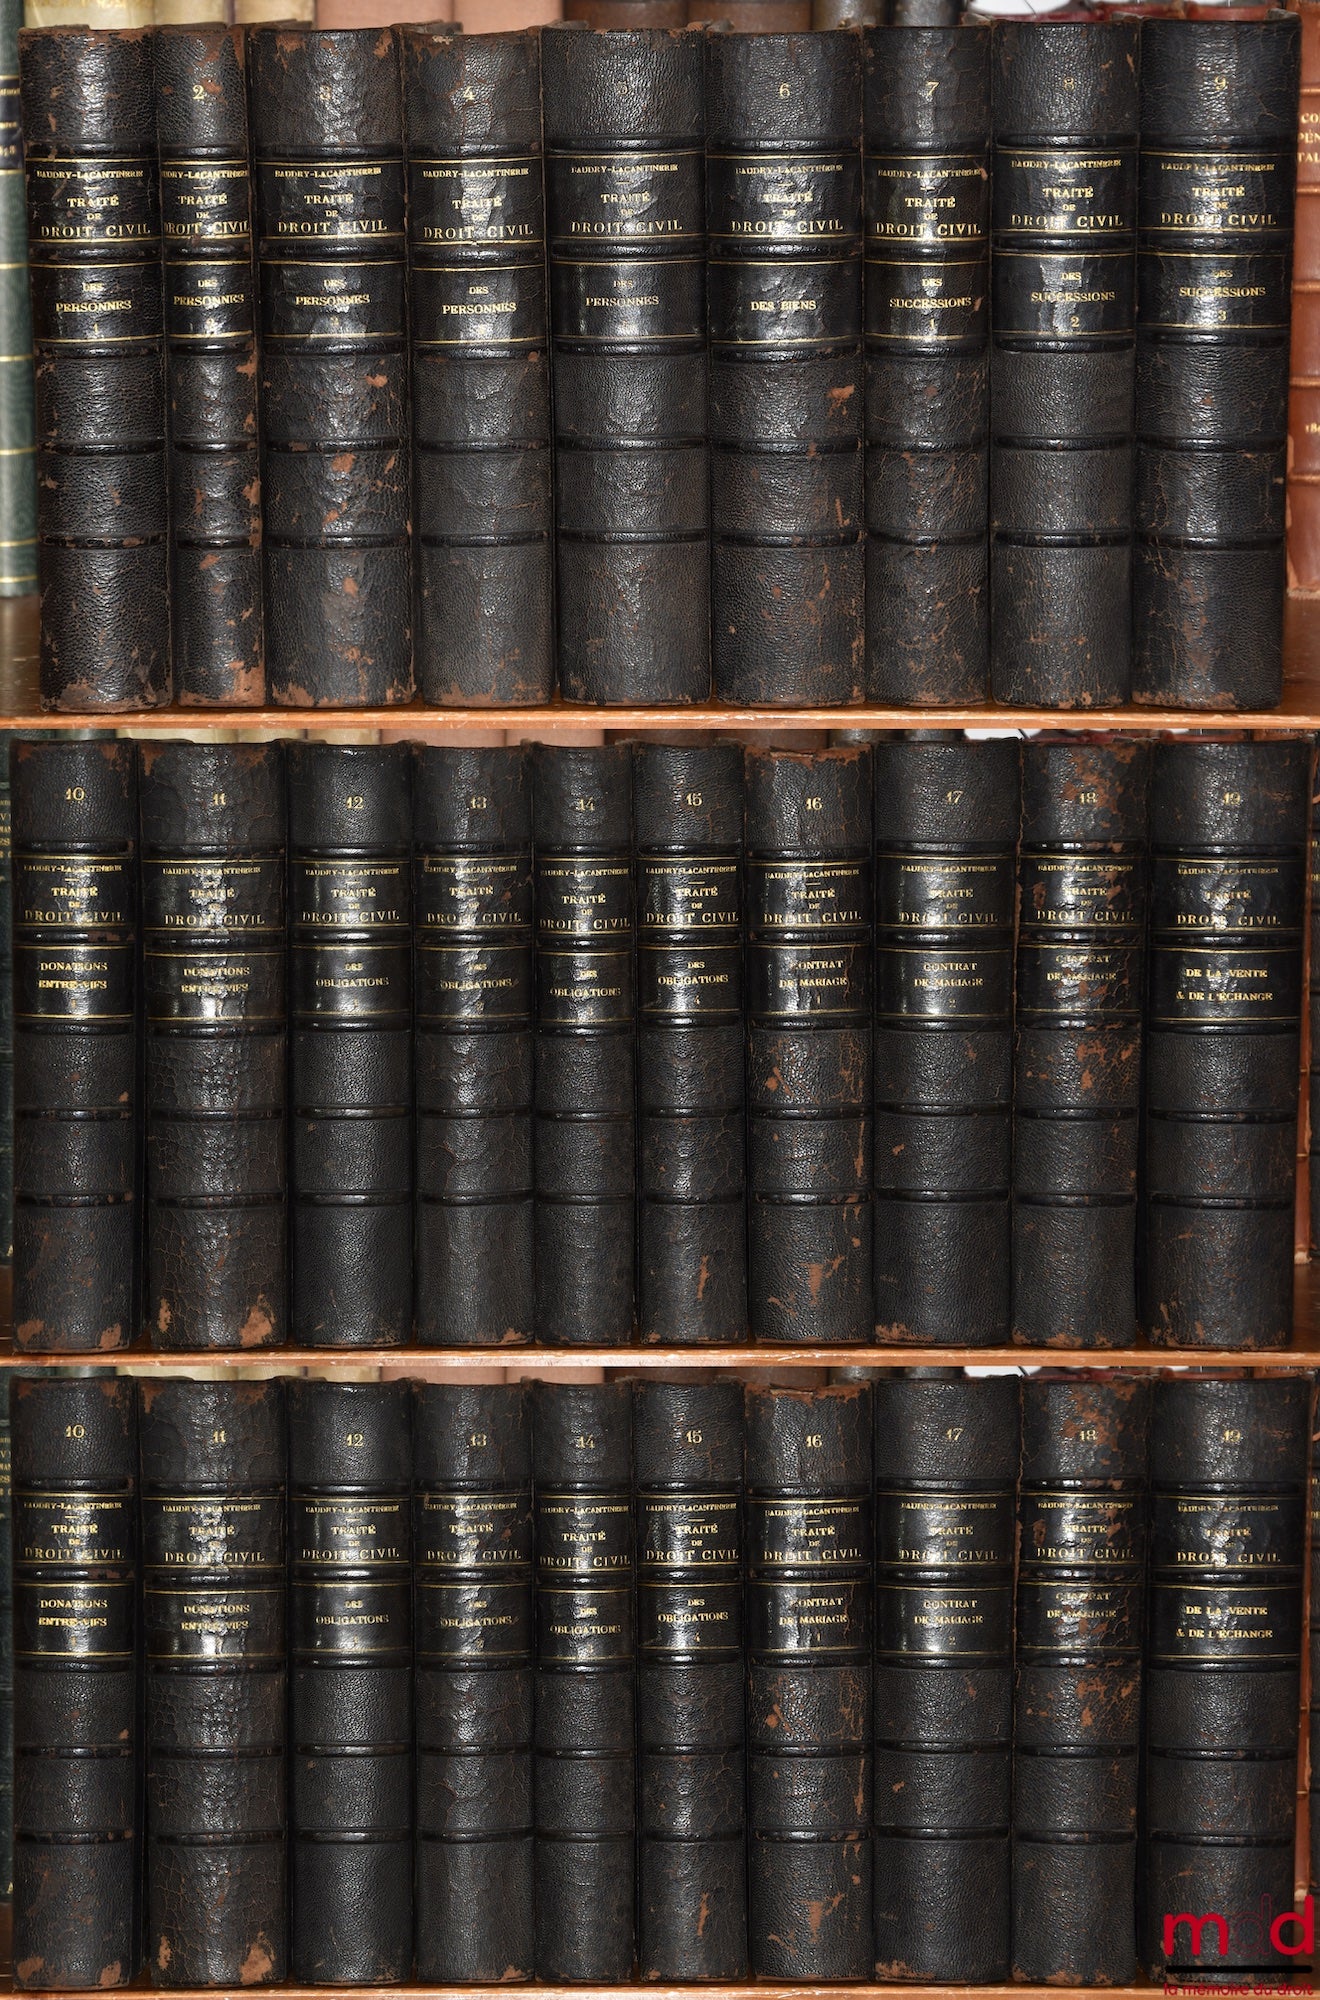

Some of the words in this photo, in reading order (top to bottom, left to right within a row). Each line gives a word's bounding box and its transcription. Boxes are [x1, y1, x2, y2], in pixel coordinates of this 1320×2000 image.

[927, 82, 939, 96] 7
[1064, 78, 1075, 90] 8
[1216, 78, 1226, 90] 9
[193, 86, 204, 99] 2
[463, 87, 475, 99] 4
[779, 84, 790, 99] 6
[763, 191, 813, 202] TRAITÉ
[1043, 186, 1094, 198] TRAITÉ
[1192, 186, 1245, 196] TRAITÉ
[68, 195, 118, 207] TRAITÉ
[178, 194, 227, 205] TRAITÉ
[304, 193, 353, 204] TRAITÉ
[452, 197, 502, 209] TRAITÉ
[601, 192, 650, 203] TRAITÉ
[905, 197, 955, 208] TRAITÉ
[1011, 215, 1068, 227] DROIT
[1077, 215, 1123, 227] CIVIL
[1161, 213, 1217, 225] DROIT
[1228, 213, 1276, 225] CIVIL
[41, 226, 93, 238] DROIT
[106, 225, 150, 236] CIVIL
[163, 224, 200, 234] DROIT
[213, 222, 249, 233] CIVIL
[278, 222, 330, 234] DROIT
[338, 220, 387, 232] CIVIL
[424, 226, 475, 238] DROIT
[488, 225, 533, 237] CIVIL
[571, 221, 620, 233] DROIT
[635, 220, 682, 232] CIVIL
[732, 220, 785, 232] DROIT
[798, 220, 843, 232] CIVIL
[876, 223, 923, 235] DROIT
[938, 223, 981, 235] CIVIL
[1062, 272, 1081, 280] DES
[82, 283, 104, 292] DES
[324, 280, 345, 288] DES
[922, 279, 942, 287] DES
[1031, 291, 1115, 302] SUCCESSIONS
[1179, 287, 1266, 297] SUCCESSIONS
[173, 295, 244, 306] PERSONNES
[296, 295, 370, 305] PERSONNES
[586, 296, 659, 307] PERSONNES
[890, 298, 971, 309] SUCCESSIONS
[55, 301, 132, 312] PERSONNES
[442, 303, 516, 315] PERSONNES
[751, 301, 774, 311] DES
[781, 301, 816, 311] BIENS
[1071, 316, 1079, 327] 2
[1219, 311, 1227, 321] 3
[66, 787, 85, 800] 10
[946, 791, 964, 804] 17
[1223, 792, 1240, 805] 19
[347, 797, 363, 809] 12
[686, 794, 702, 806] 15
[806, 798, 822, 810] 16
[52, 886, 98, 896] TRAITÉ
[331, 888, 376, 897] TRAITÉ
[676, 887, 718, 896] TRAITÉ
[792, 889, 835, 898] TRAITÉ
[563, 893, 605, 903] TRAITÉ
[25, 910, 74, 922] DROIT
[81, 911, 124, 922] CIVIL
[165, 915, 214, 925] DROIT
[224, 914, 265, 925] CIVIL
[303, 911, 350, 922] DROIT
[360, 910, 399, 922] CIVIL
[427, 913, 476, 923] DROIT
[482, 912, 521, 922] CIVIL
[646, 913, 695, 922] DROIT
[702, 912, 738, 922] CIVIL
[764, 913, 811, 923] DROIT
[822, 911, 861, 922] CIVIL
[958, 913, 997, 923] CIVIL
[1037, 910, 1085, 921] DROIT
[1095, 911, 1134, 921] CIVIL
[1238, 915, 1280, 925] CIVIL
[540, 919, 582, 929] DROIT
[593, 918, 630, 929] CIVIL
[40, 962, 107, 971] DONATIONS
[924, 963, 977, 971] CONTRAT
[1186, 969, 1201, 977] DE
[1206, 969, 1222, 978] LA
[1229, 969, 1267, 978] VENTE
[316, 978, 389, 987] OBLIGATIONS
[440, 979, 512, 989] OBLIGATIONS
[658, 975, 728, 984] OBLIGATIONS
[800, 978, 847, 987] MARIAGE
[550, 988, 621, 997] OBLIGATIONS
[1177, 992, 1184, 1000] &
[1189, 992, 1204, 1001] DE
[1209, 992, 1272, 1001] L'ÉCHANGE
[66, 1424, 85, 1437] 10
[946, 1428, 964, 1441] 17
[347, 1434, 363, 1446] 12
[686, 1431, 702, 1443] 15
[806, 1435, 822, 1447] 16
[52, 1523, 98, 1533] TRAITÉ
[331, 1525, 376, 1534] TRAITÉ
[676, 1524, 718, 1533] TRAITÉ
[563, 1530, 605, 1540] TRAITÉ
[25, 1547, 74, 1559] DROIT
[224, 1551, 265, 1562] CIVIL
[303, 1548, 350, 1559] DROIT
[360, 1547, 399, 1559] CIVIL
[482, 1549, 521, 1559] CIVIL
[646, 1550, 695, 1559] DROIT
[702, 1549, 738, 1559] CIVIL
[764, 1550, 811, 1560] DROIT
[822, 1548, 861, 1559] CIVIL
[958, 1550, 997, 1560] CIVIL
[1095, 1548, 1134, 1558] CIVIL
[1238, 1552, 1280, 1562] CIVIL
[540, 1556, 582, 1566] DROIT
[593, 1555, 630, 1566] CIVIL
[40, 1599, 107, 1608] DONATIONS
[1206, 1606, 1222, 1615] LA
[316, 1615, 389, 1624] OBLIGATIONS
[440, 1616, 512, 1626] OBLIGATIONS
[658, 1612, 728, 1621] OBLIGATIONS
[800, 1615, 847, 1624] MARIAGE
[550, 1625, 621, 1634] OBLIGATIONS
